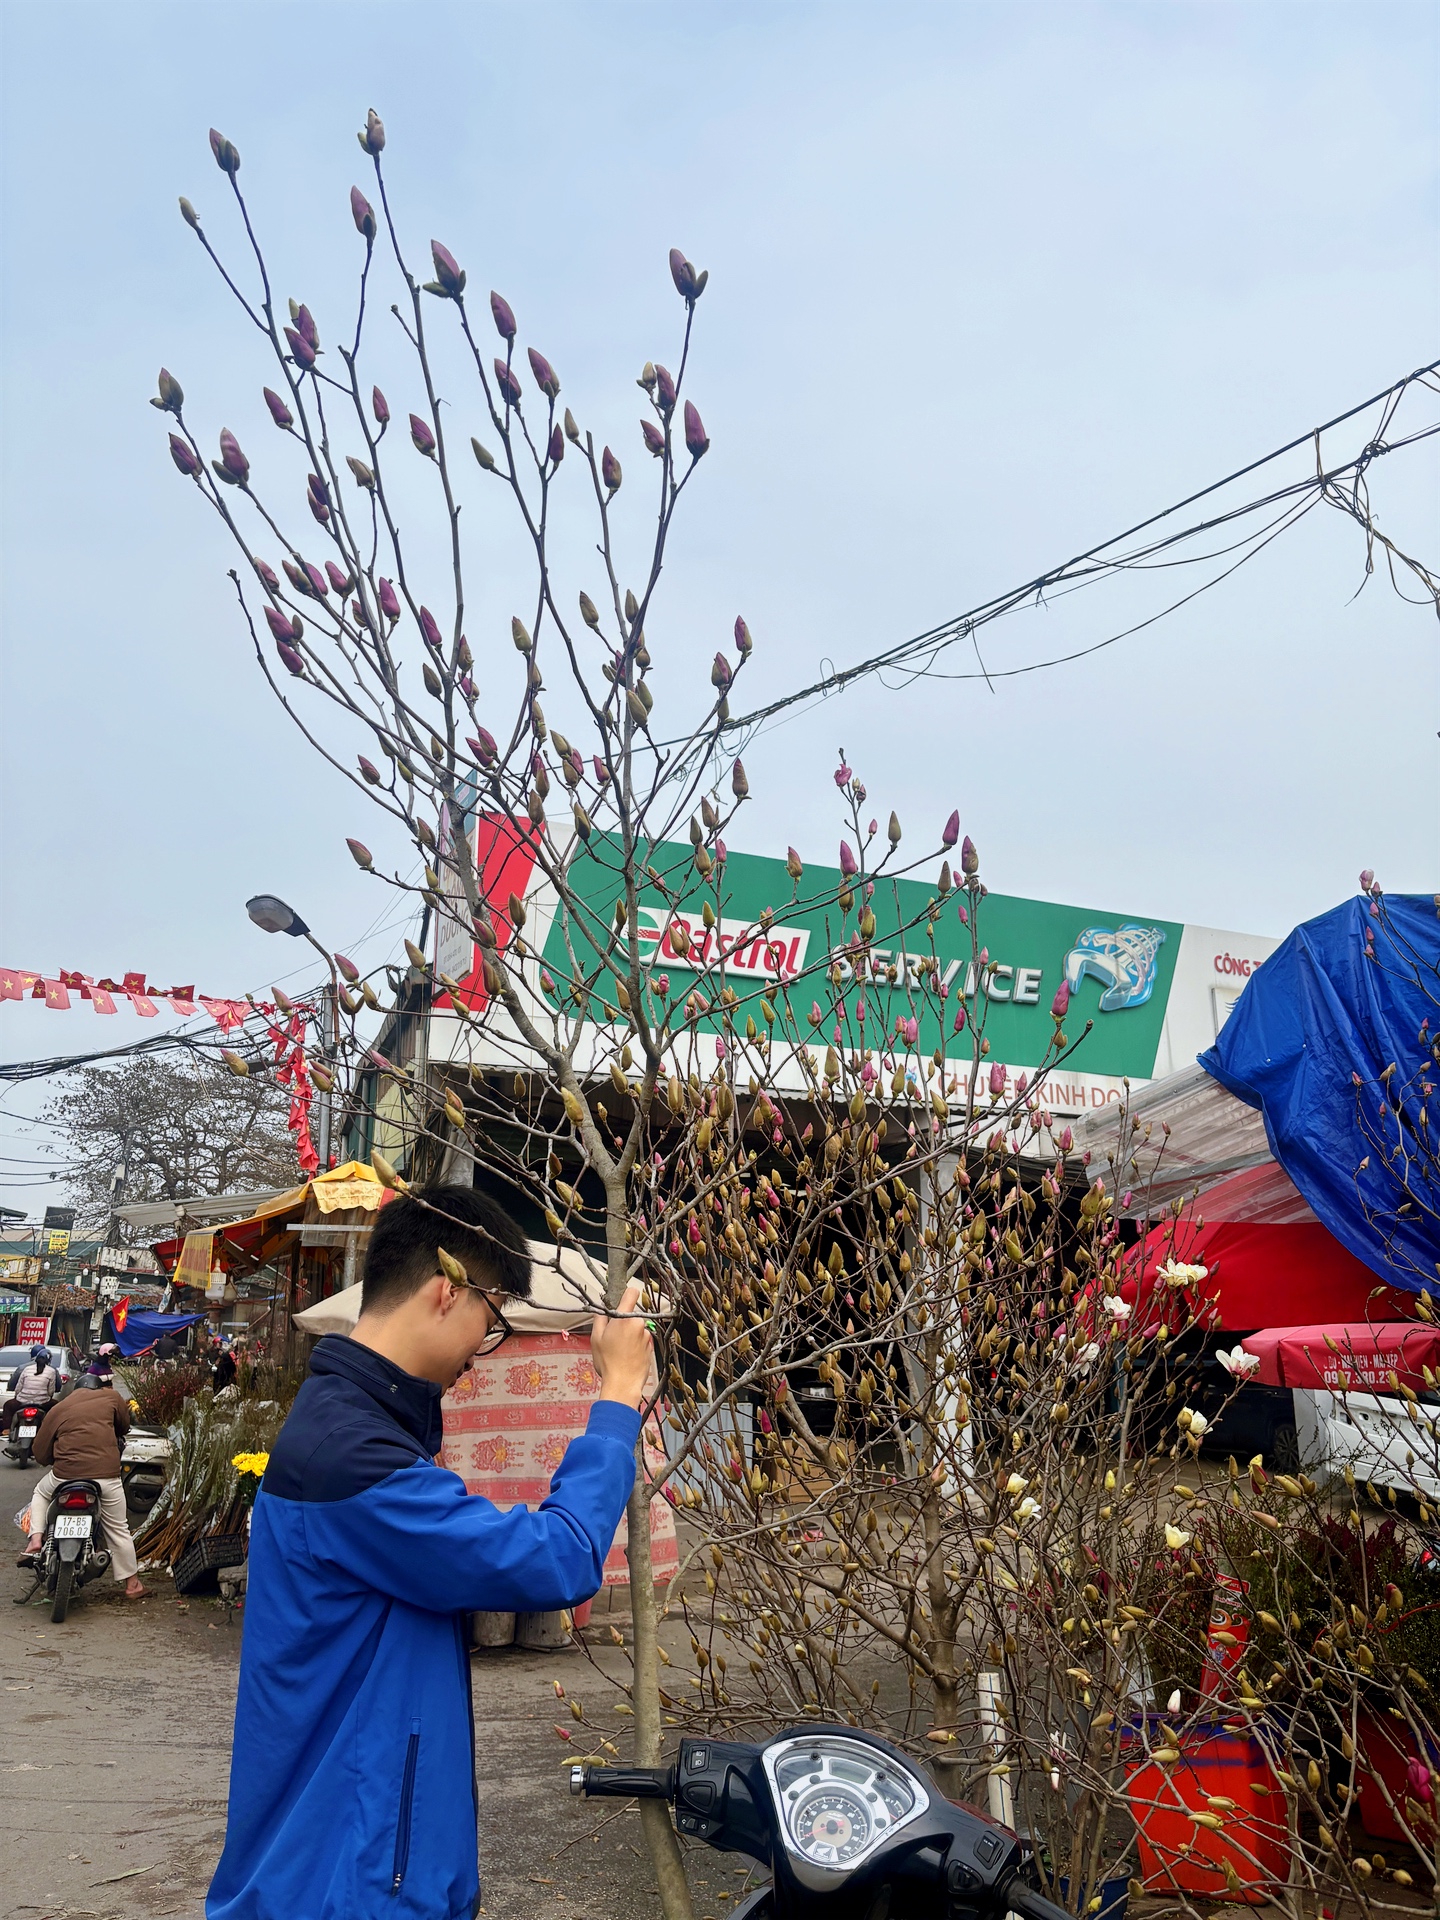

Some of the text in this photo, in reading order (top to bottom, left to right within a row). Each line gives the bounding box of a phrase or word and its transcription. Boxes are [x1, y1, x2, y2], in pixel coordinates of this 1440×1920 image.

[662, 919, 1044, 1004] Castrol SERVICE
[1213, 952, 1251, 977] CÔNG
[1035, 1082, 1086, 1107] KINH
[24, 1321, 45, 1329] CƠM
[63, 1516, 87, 1527] 17-B5
[56, 1527, 89, 1537] 706.02
